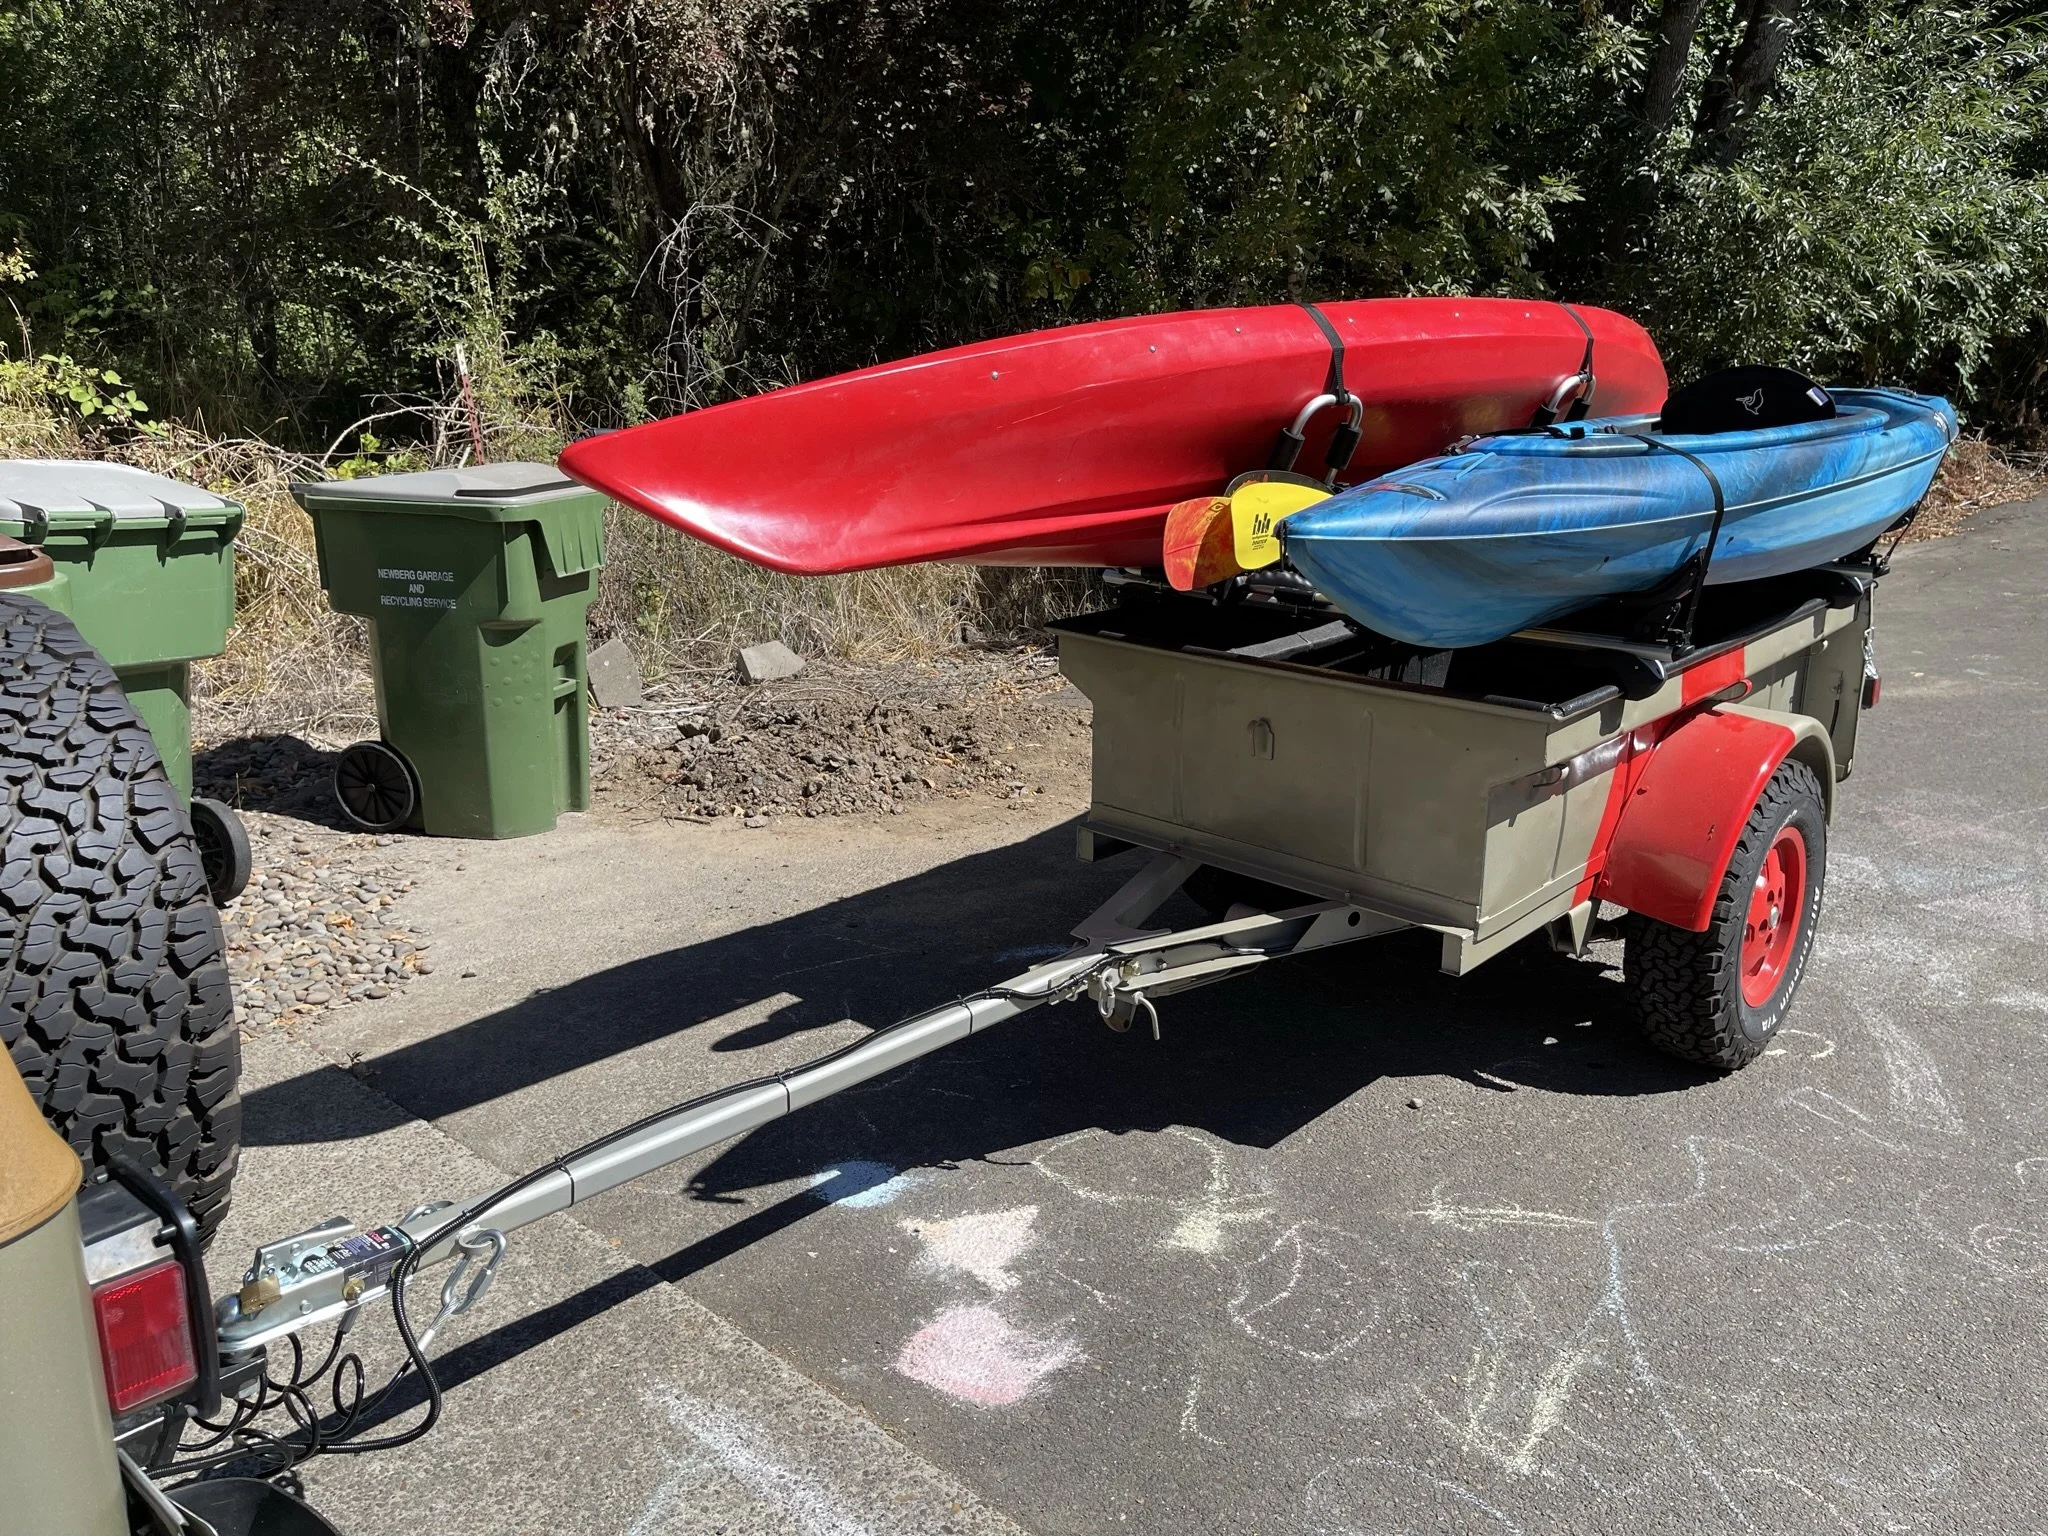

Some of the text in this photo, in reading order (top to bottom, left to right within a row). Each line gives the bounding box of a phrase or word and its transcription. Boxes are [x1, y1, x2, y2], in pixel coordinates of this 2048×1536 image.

[378, 568, 454, 582] NEWBERG GARBAGE
[409, 584, 424, 593] AND
[381, 595, 456, 609] RECYCLING SERVICE
